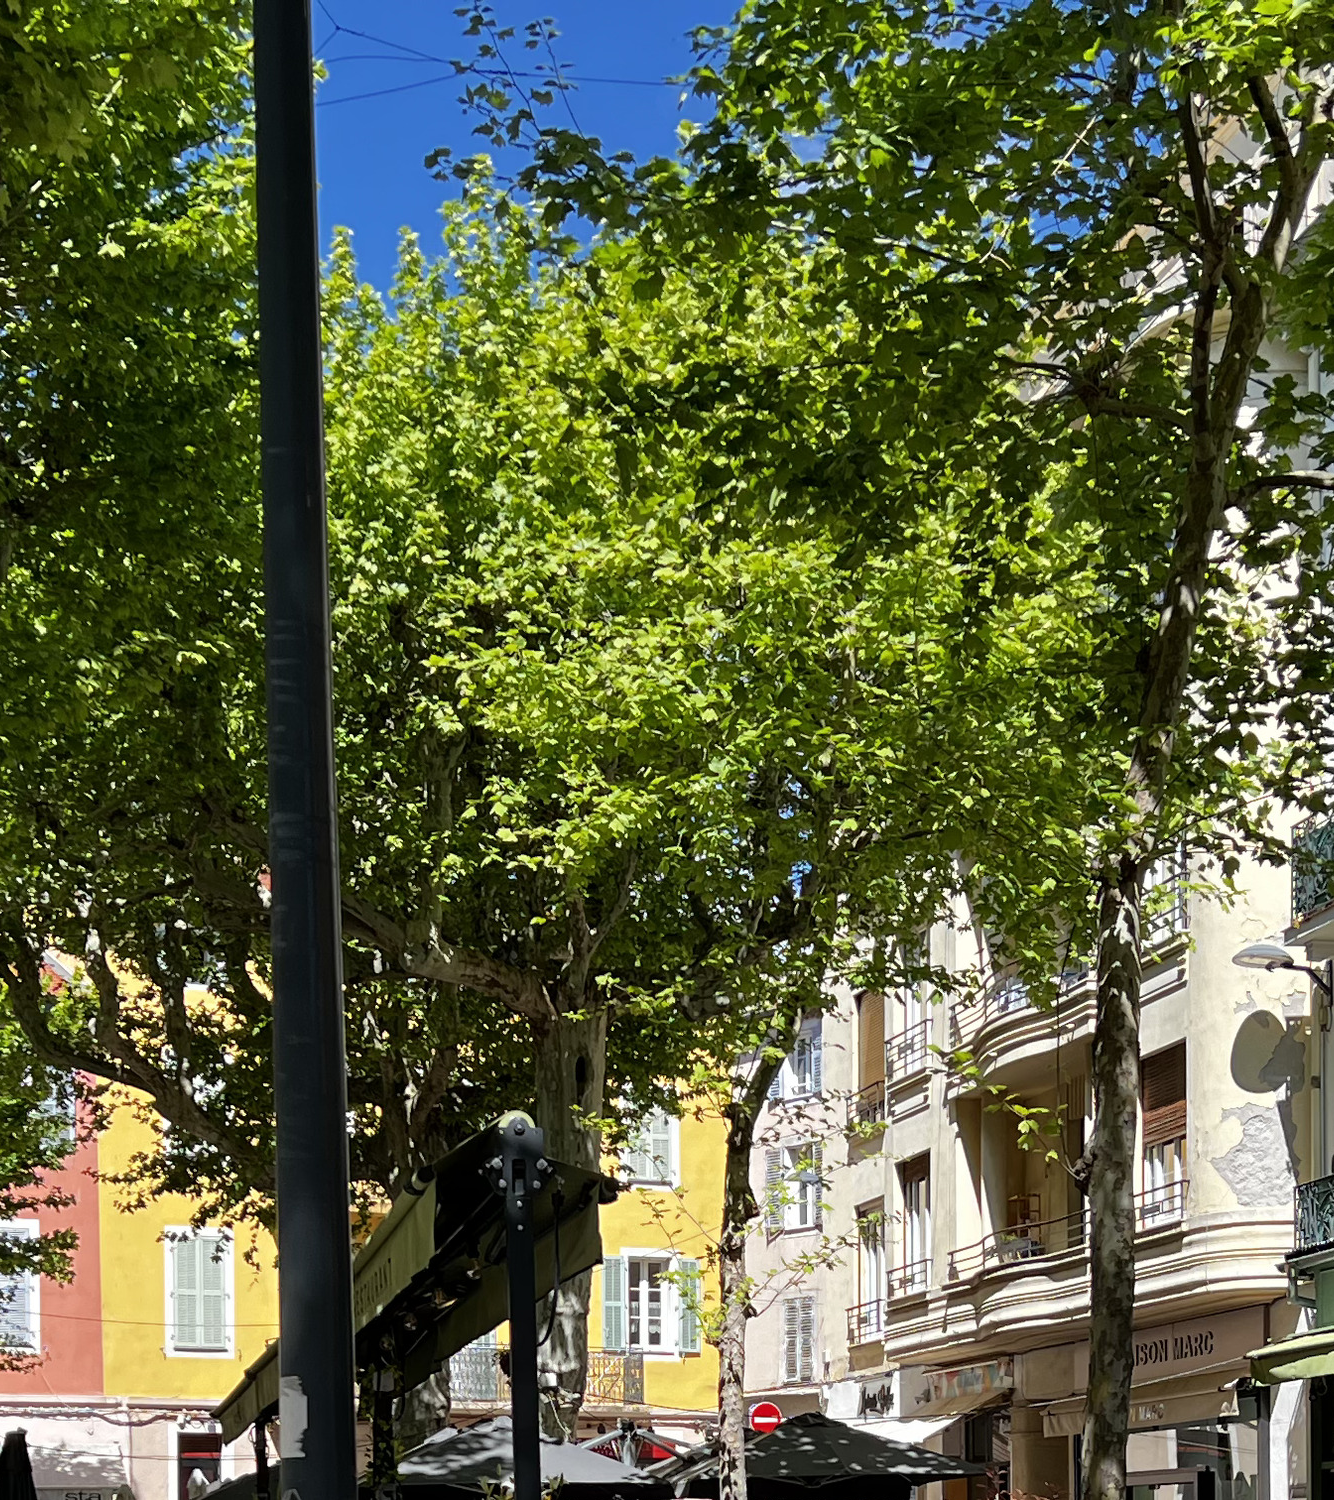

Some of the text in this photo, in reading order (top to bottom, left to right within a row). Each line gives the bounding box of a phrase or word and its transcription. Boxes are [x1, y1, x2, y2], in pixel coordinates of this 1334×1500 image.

[355, 1257, 393, 1317] ESTAURANT
[1133, 1330, 1215, 1367] ISON MARC
[1139, 1402, 1164, 1422] MARC
